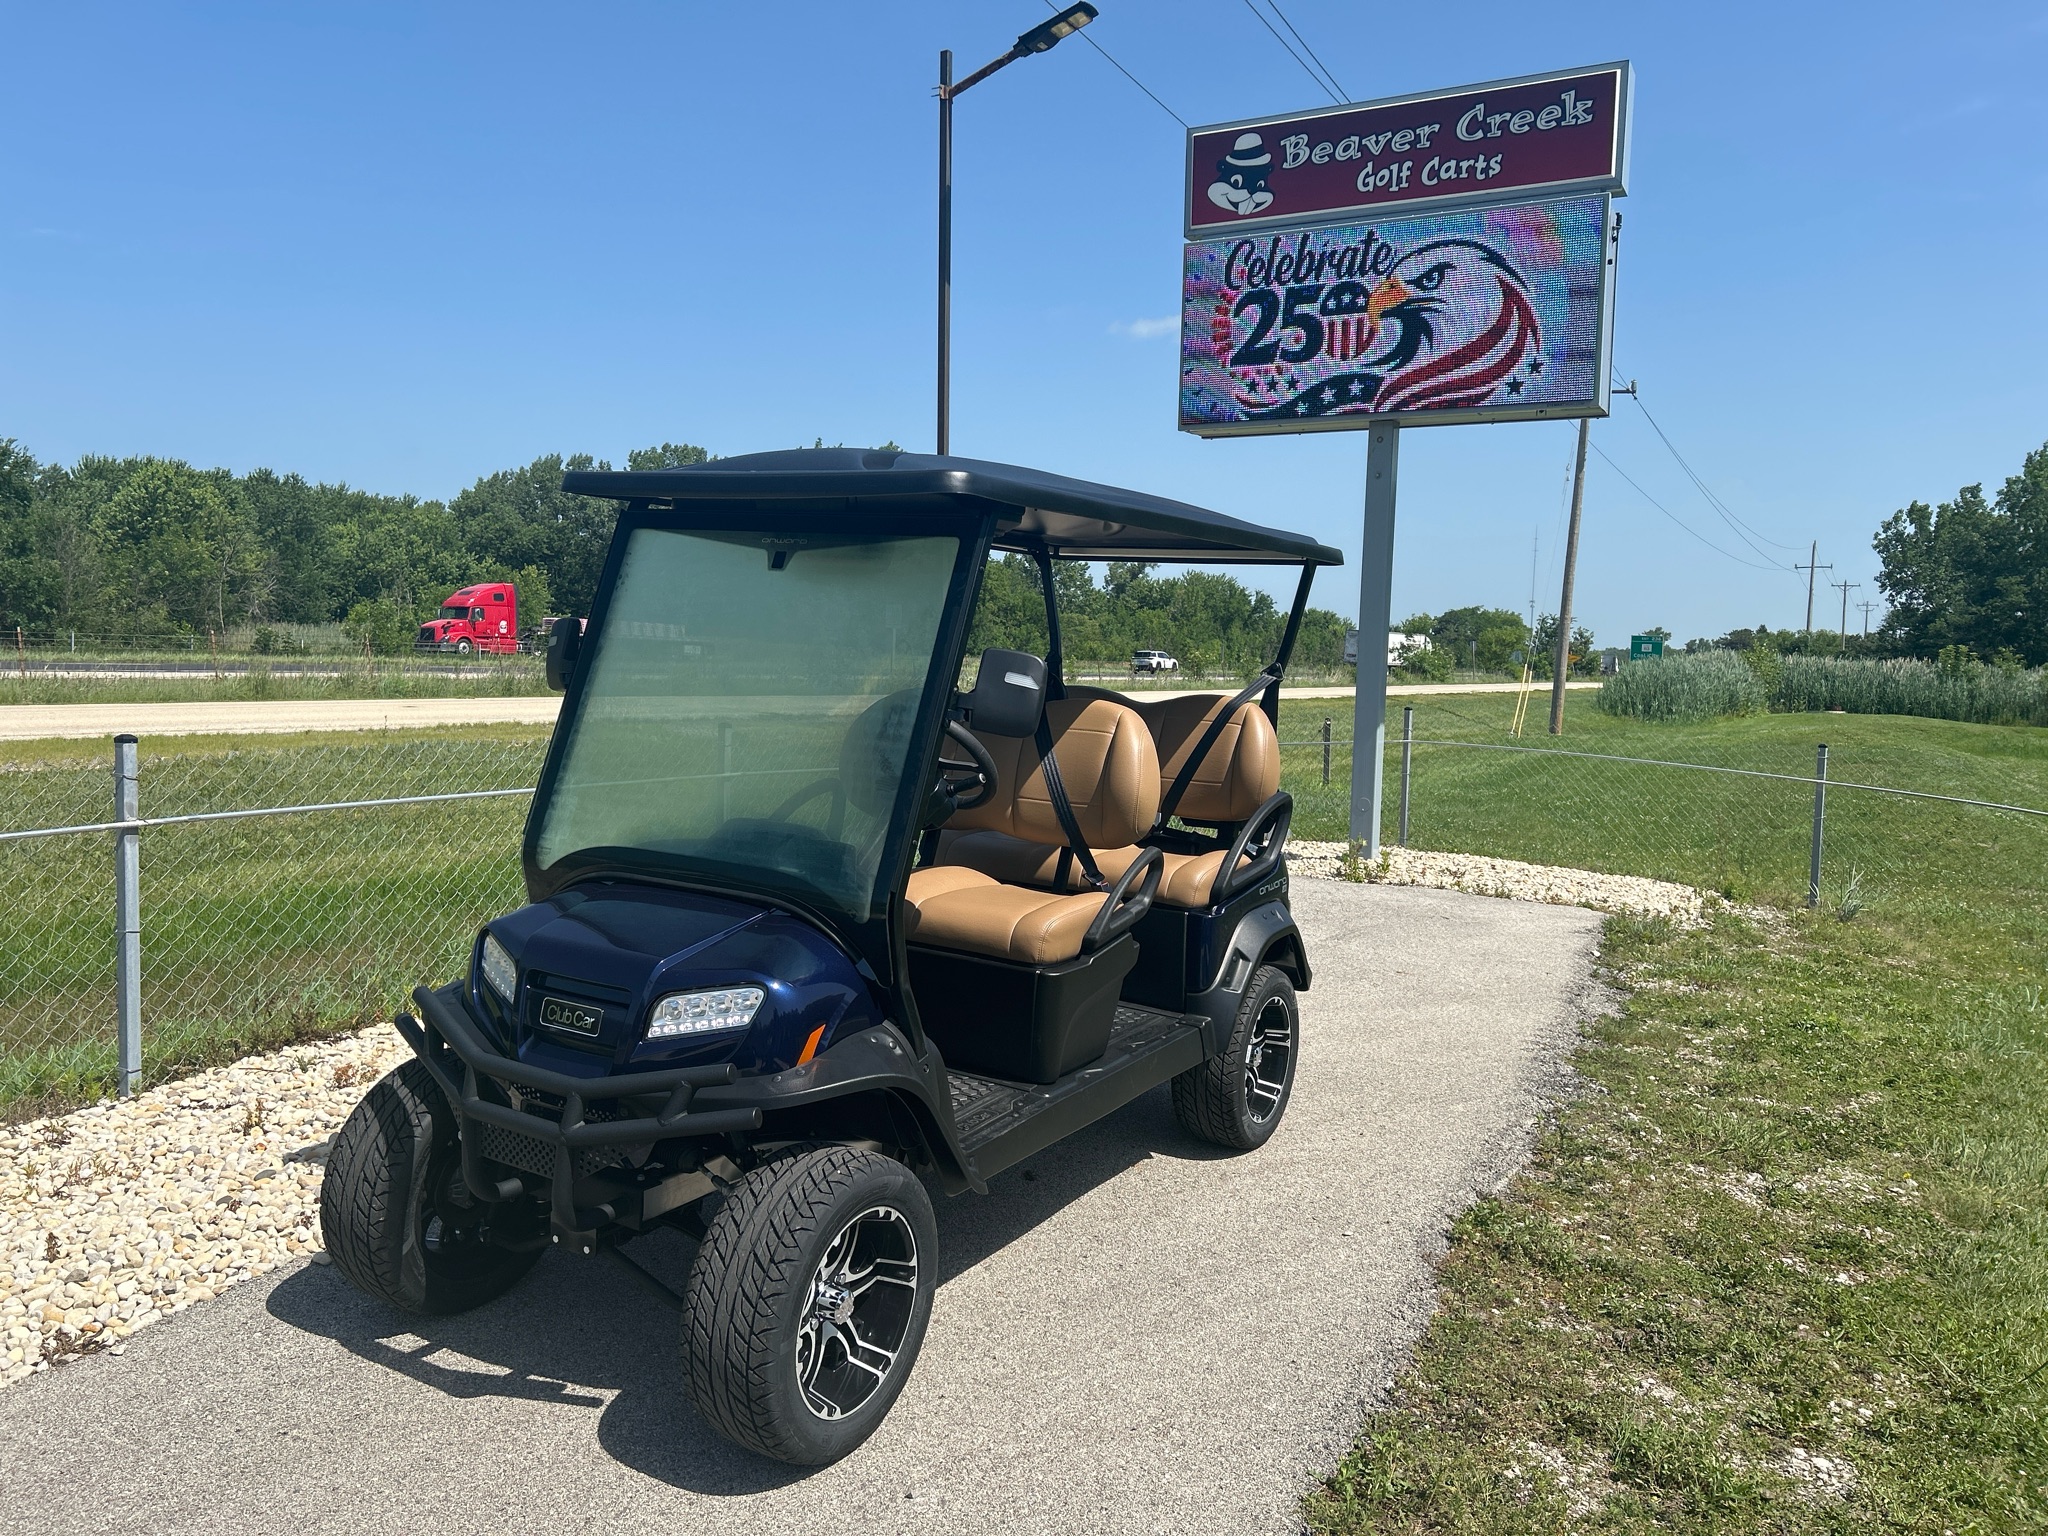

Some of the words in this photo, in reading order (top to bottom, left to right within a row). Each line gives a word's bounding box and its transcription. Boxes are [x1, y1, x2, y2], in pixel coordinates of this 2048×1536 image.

[1280, 123, 1441, 169] Beaver
[1456, 89, 1594, 141] Creek
[1356, 160, 1413, 192] Golf
[1421, 153, 1503, 186] Carts
[1225, 229, 1393, 290] Celebrate
[547, 1004, 572, 1024] Club
[573, 1010, 596, 1030] Car
